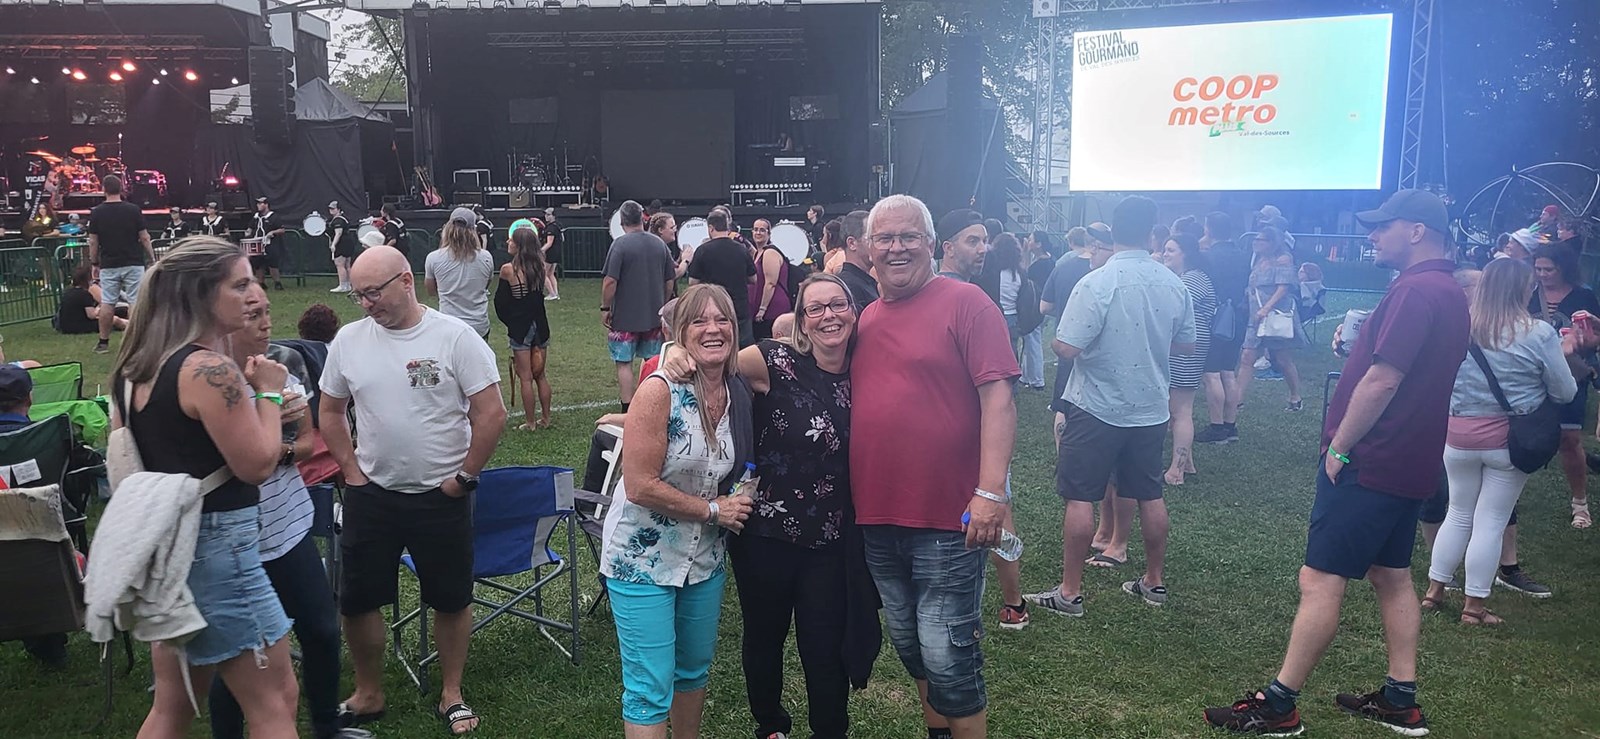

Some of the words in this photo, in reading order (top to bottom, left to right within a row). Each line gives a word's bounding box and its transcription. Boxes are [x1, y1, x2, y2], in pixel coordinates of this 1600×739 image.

[1077, 31, 1126, 52] FESTIVAL
[1079, 42, 1139, 66] GOURMAND
[1173, 74, 1280, 102] COOP
[1168, 102, 1277, 126] metro
